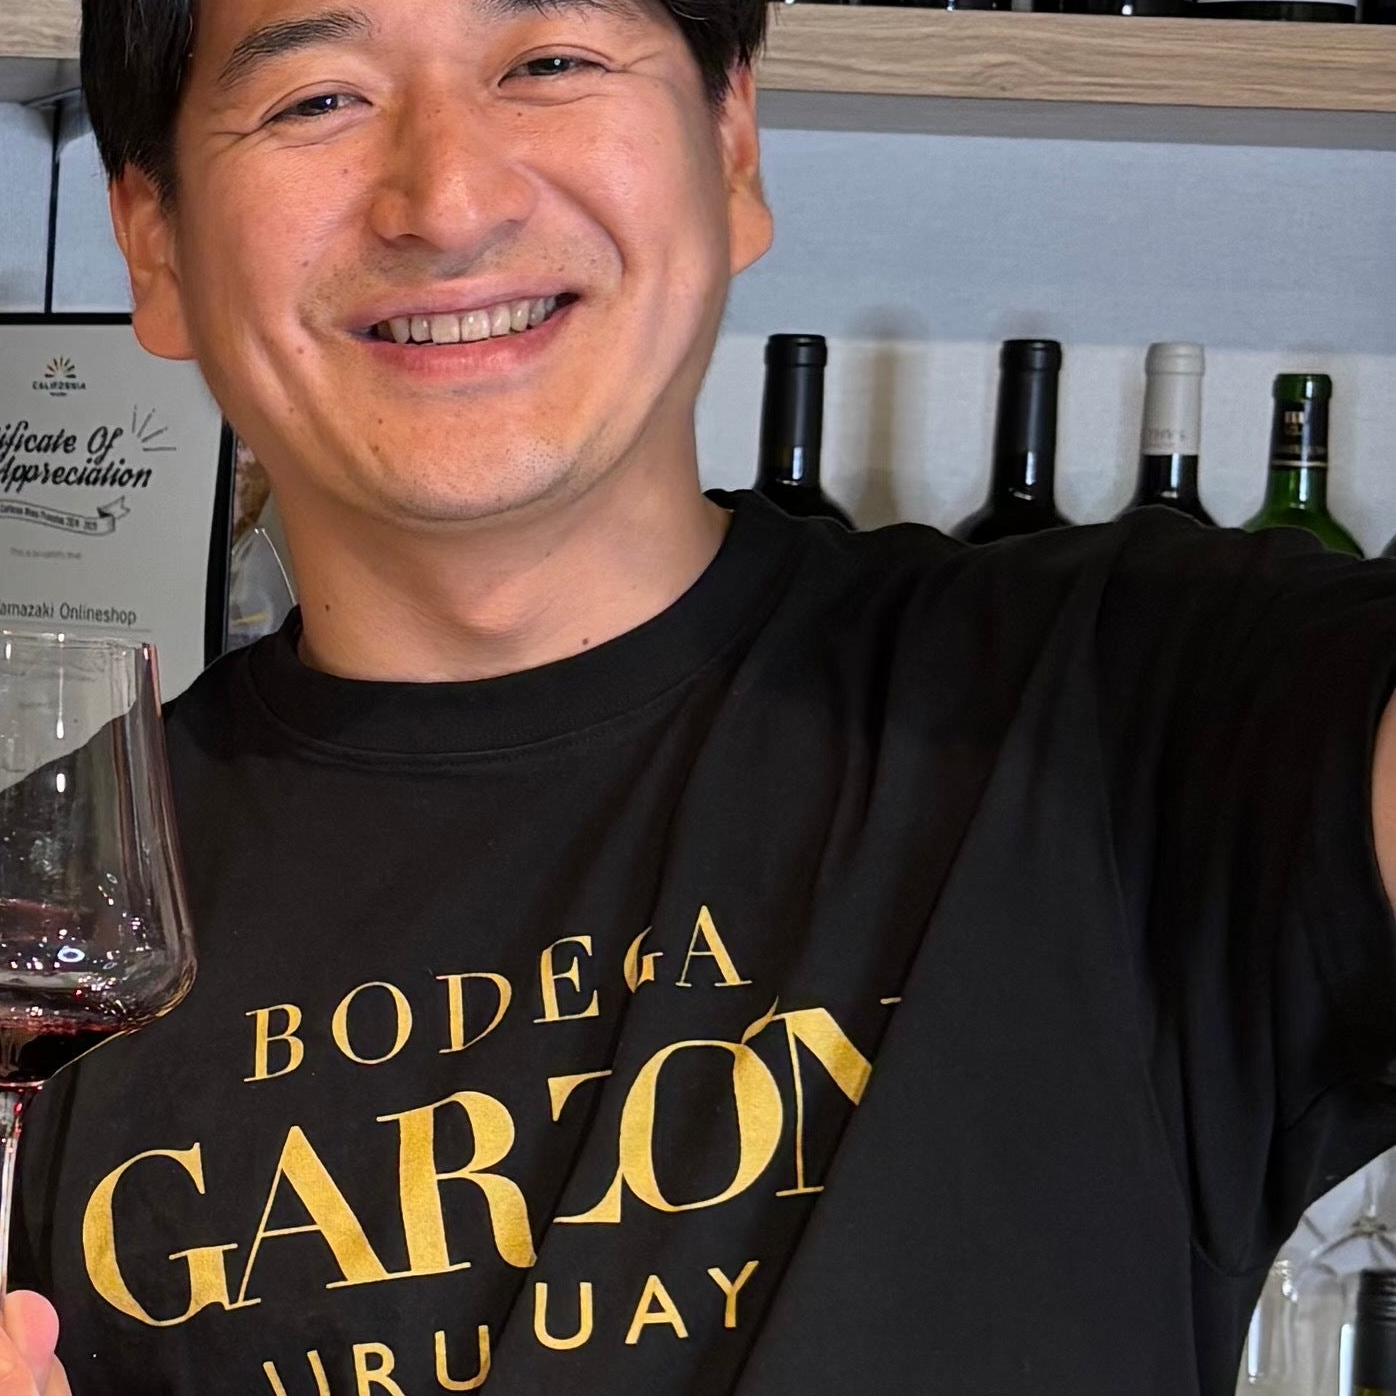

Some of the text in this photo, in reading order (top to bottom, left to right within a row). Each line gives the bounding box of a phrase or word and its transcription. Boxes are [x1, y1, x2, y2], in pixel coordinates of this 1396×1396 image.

[87, 425, 123, 466] Of
[60, 602, 137, 626] Onlineshop
[244, 905, 752, 1083] BODEGA
